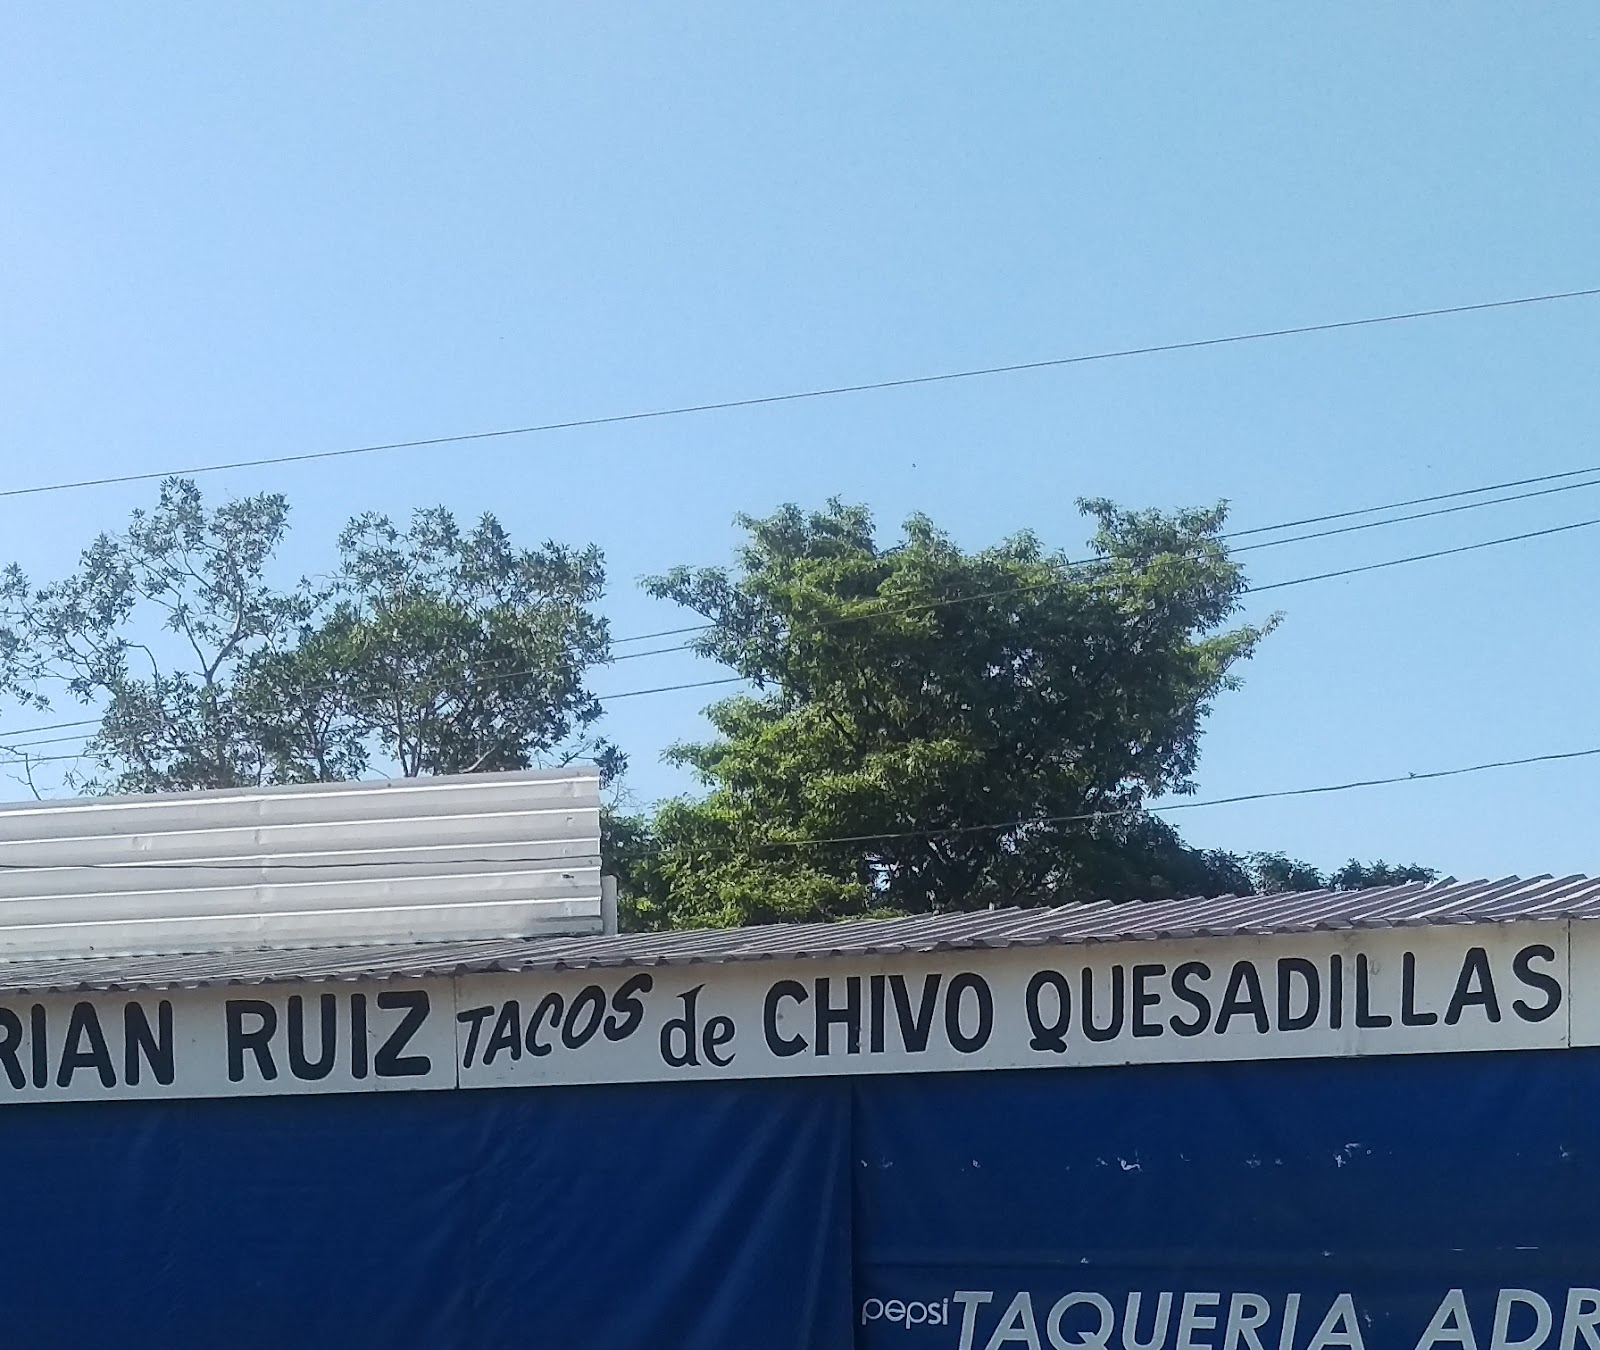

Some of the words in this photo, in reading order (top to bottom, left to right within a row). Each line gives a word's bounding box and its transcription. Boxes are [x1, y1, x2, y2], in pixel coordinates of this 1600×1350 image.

[225, 990, 432, 1083] RUIZ
[457, 973, 654, 1069] TACOS
[661, 984, 736, 1068] de
[764, 973, 994, 1058] CHIVO
[1026, 945, 1562, 1053] QUESADILLAS
[862, 1298, 949, 1329] pepsi
